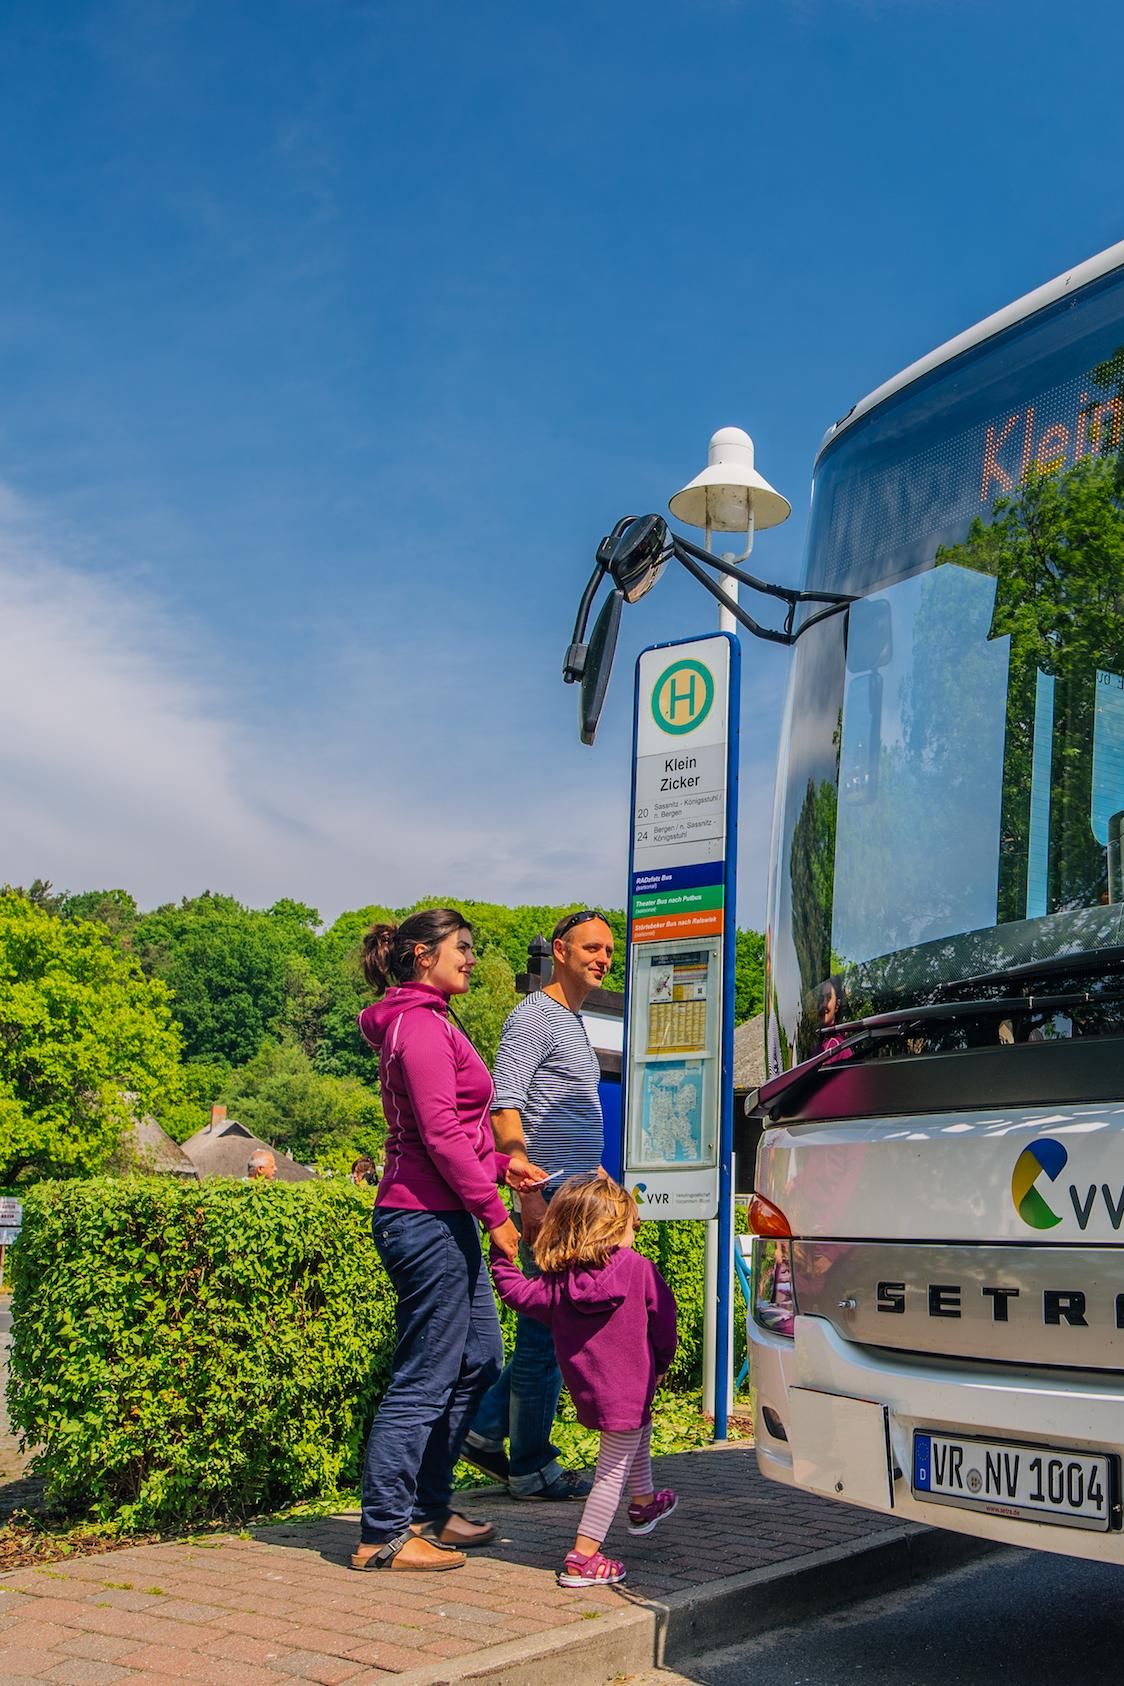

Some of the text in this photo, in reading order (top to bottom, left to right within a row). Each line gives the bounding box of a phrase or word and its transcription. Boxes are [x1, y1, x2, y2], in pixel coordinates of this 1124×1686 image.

[980, 392, 1122, 501] Klein
[670, 675, 695, 720] H
[665, 756, 697, 772] Klein
[660, 776, 701, 792] Zicker
[654, 800, 679, 811] Sassnitz
[637, 808, 649, 819] 20
[661, 809, 682, 818] Bergen
[653, 824, 675, 834] Bergen
[637, 831, 649, 842] 24
[665, 920, 677, 928] Bus
[647, 1193, 669, 1204] VVR
[919, 1443, 1104, 1511] D VR NV 1004
